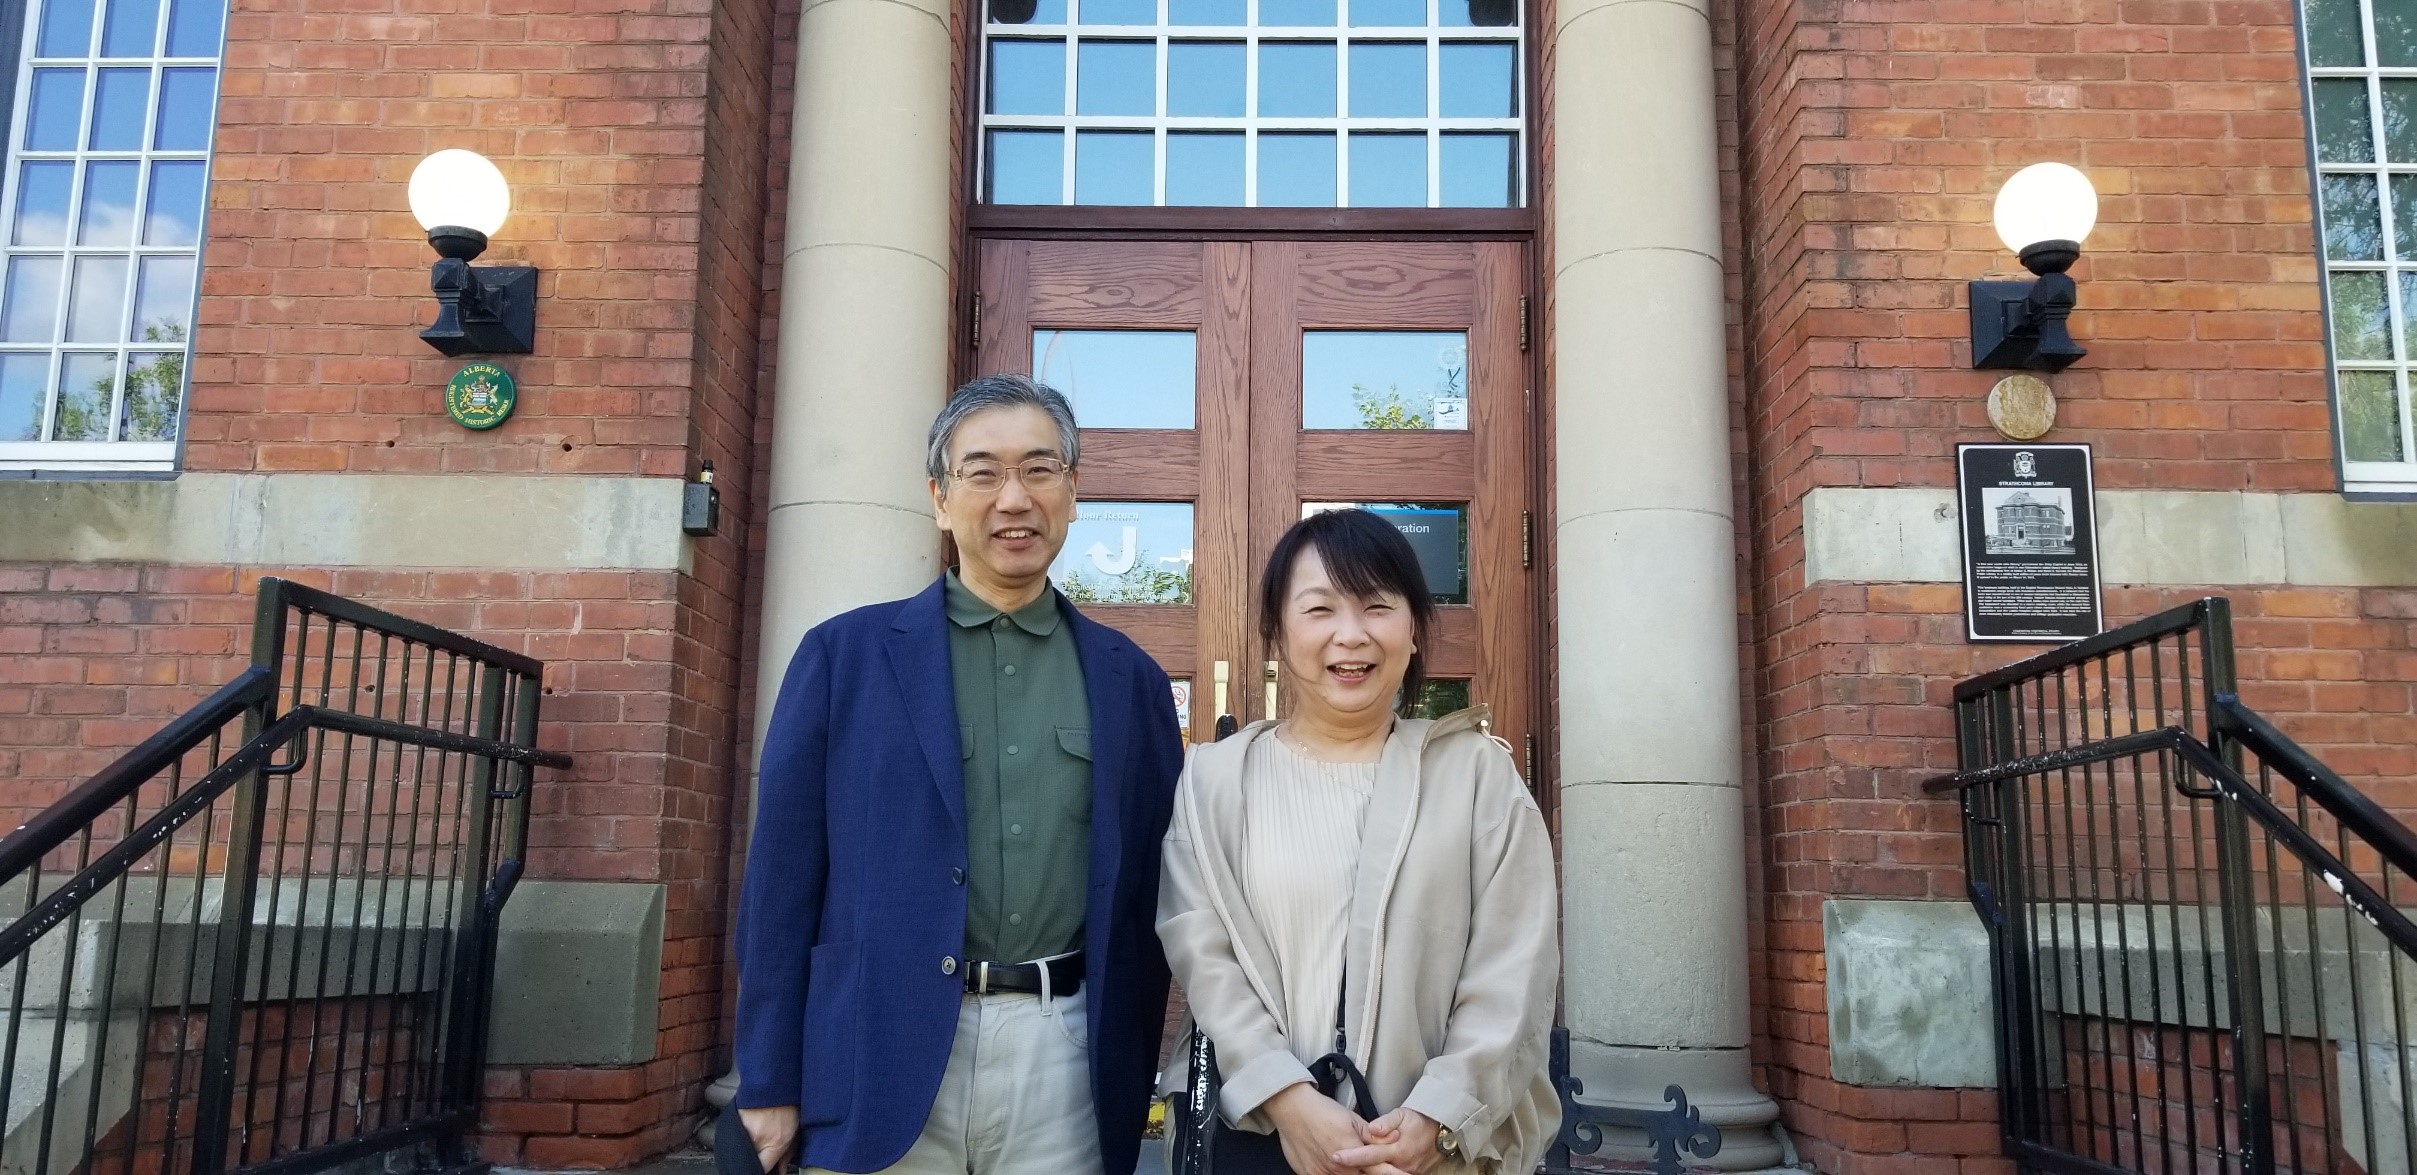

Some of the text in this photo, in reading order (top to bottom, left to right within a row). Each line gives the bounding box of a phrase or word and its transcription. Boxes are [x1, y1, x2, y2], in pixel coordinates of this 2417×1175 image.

[463, 366, 501, 377] ALBERTA
[448, 384, 464, 419] REGISTERED
[464, 416, 496, 425] HISTORIC
[1105, 511, 1139, 522] Return
